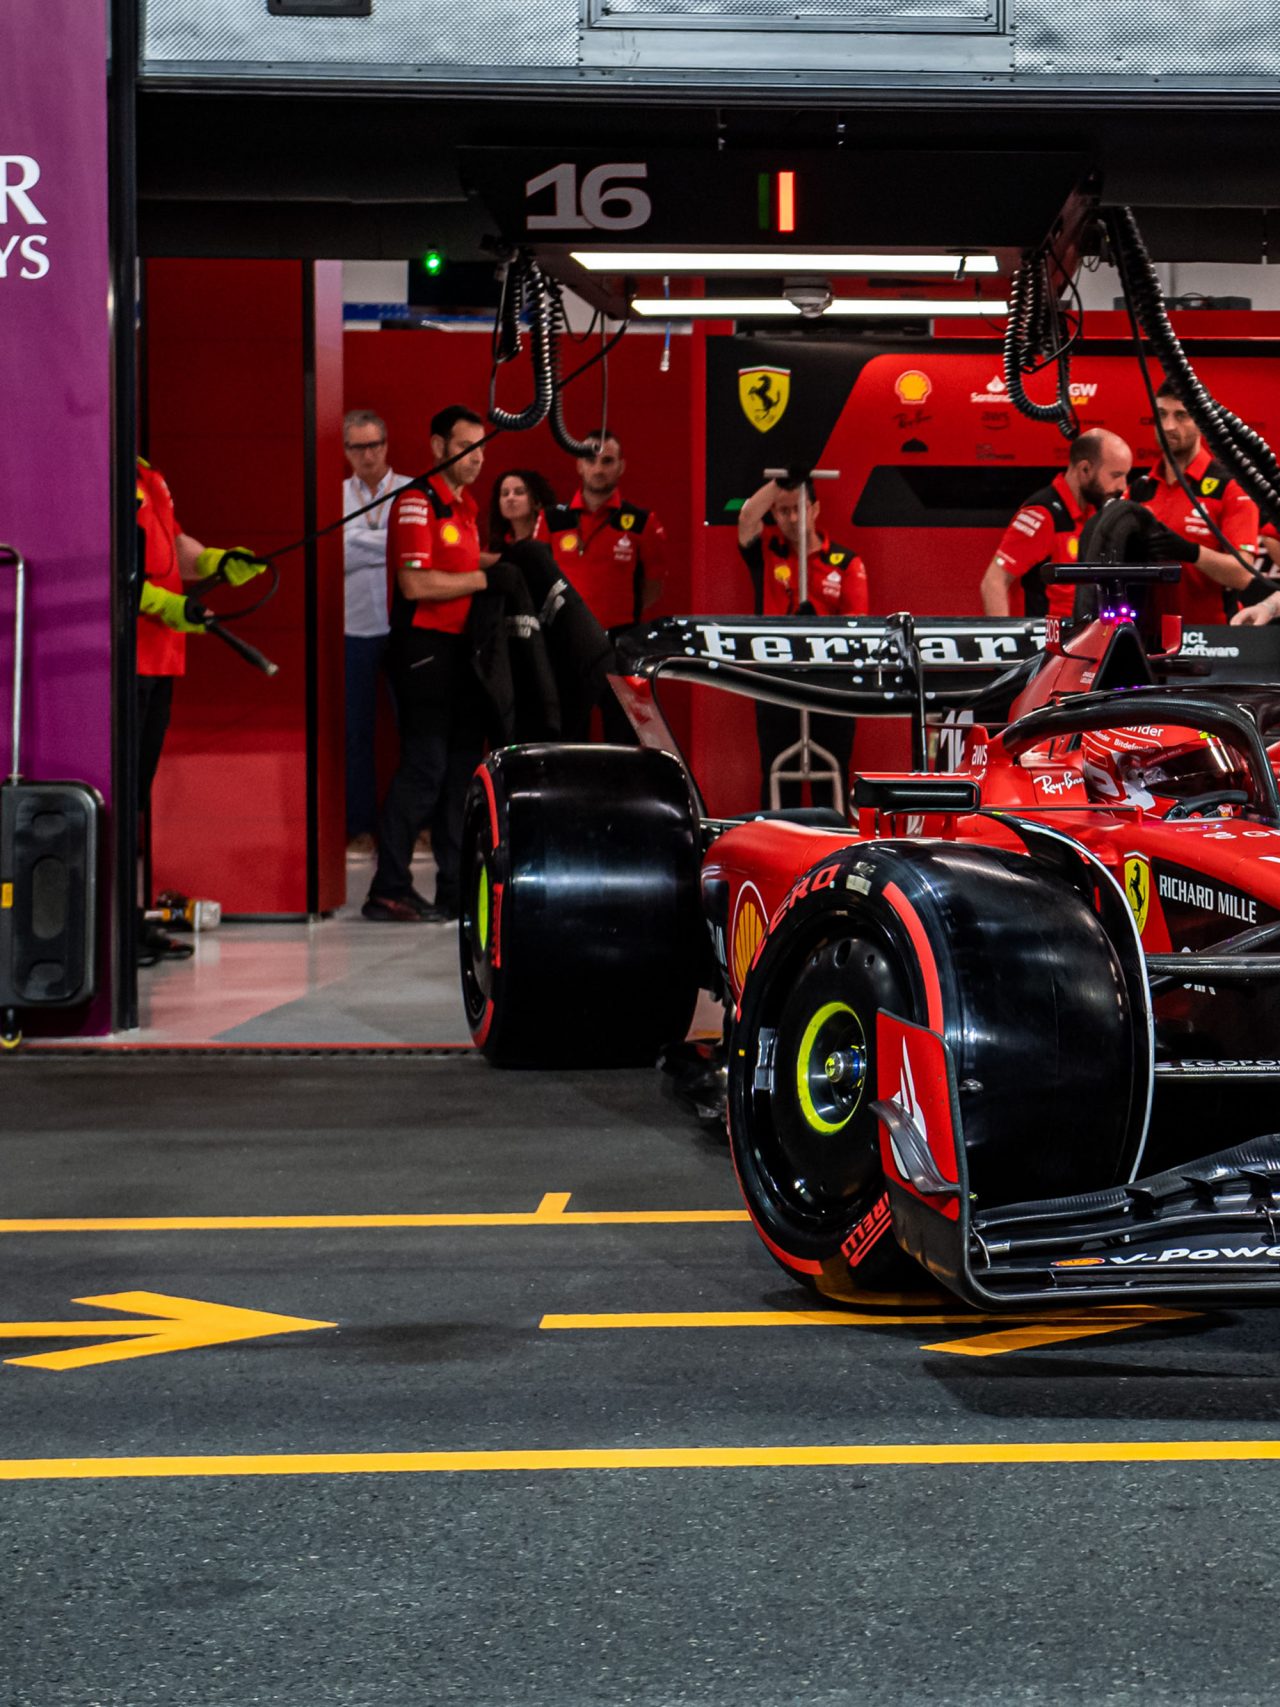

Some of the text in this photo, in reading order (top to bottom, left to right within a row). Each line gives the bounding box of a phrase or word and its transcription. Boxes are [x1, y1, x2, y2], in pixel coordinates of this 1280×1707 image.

[526, 163, 651, 230] 16
[1068, 383, 1098, 396] GW
[1160, 874, 1257, 924] RICHARD MILLE
[840, 1191, 892, 1268] IRELLI
